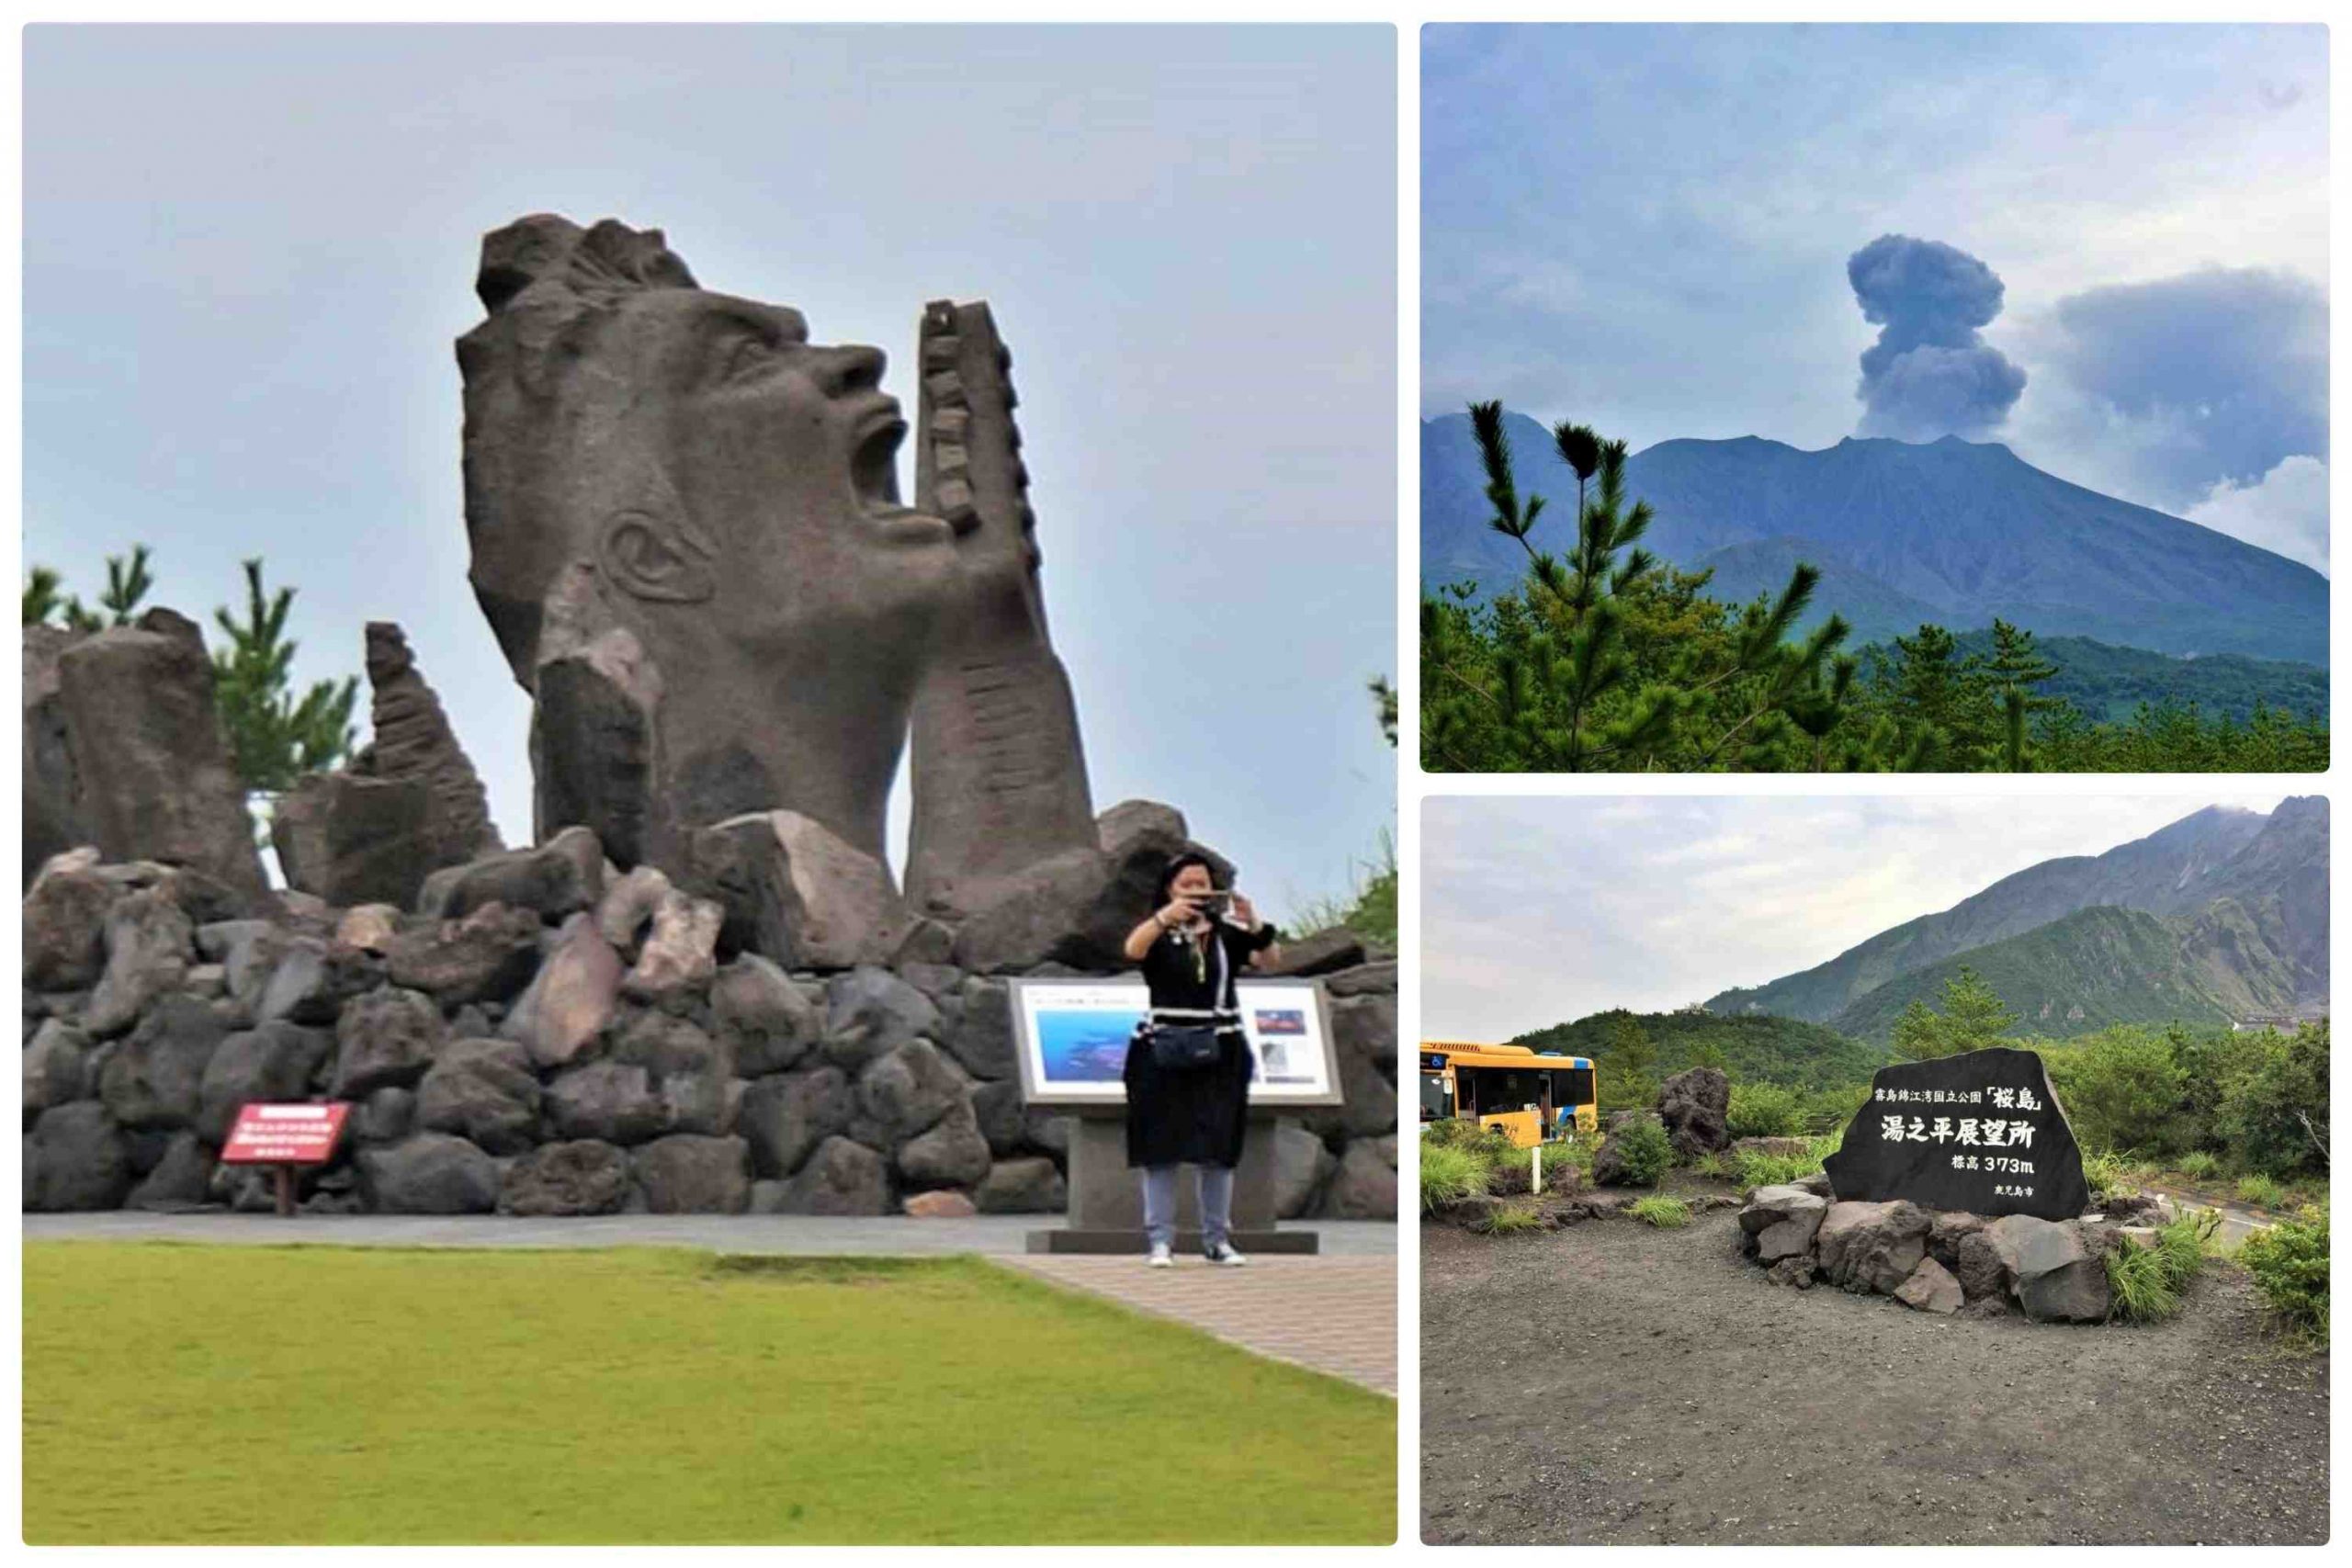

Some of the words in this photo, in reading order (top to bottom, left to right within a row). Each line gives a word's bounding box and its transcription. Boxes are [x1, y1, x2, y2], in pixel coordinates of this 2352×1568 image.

[1882, 1115, 2036, 1148] 湯之平展望所
[1951, 1155, 1979, 1170] 標高
[1984, 1156, 2035, 1174] 373m
[1994, 1184, 2034, 1197] 鹿児島市
